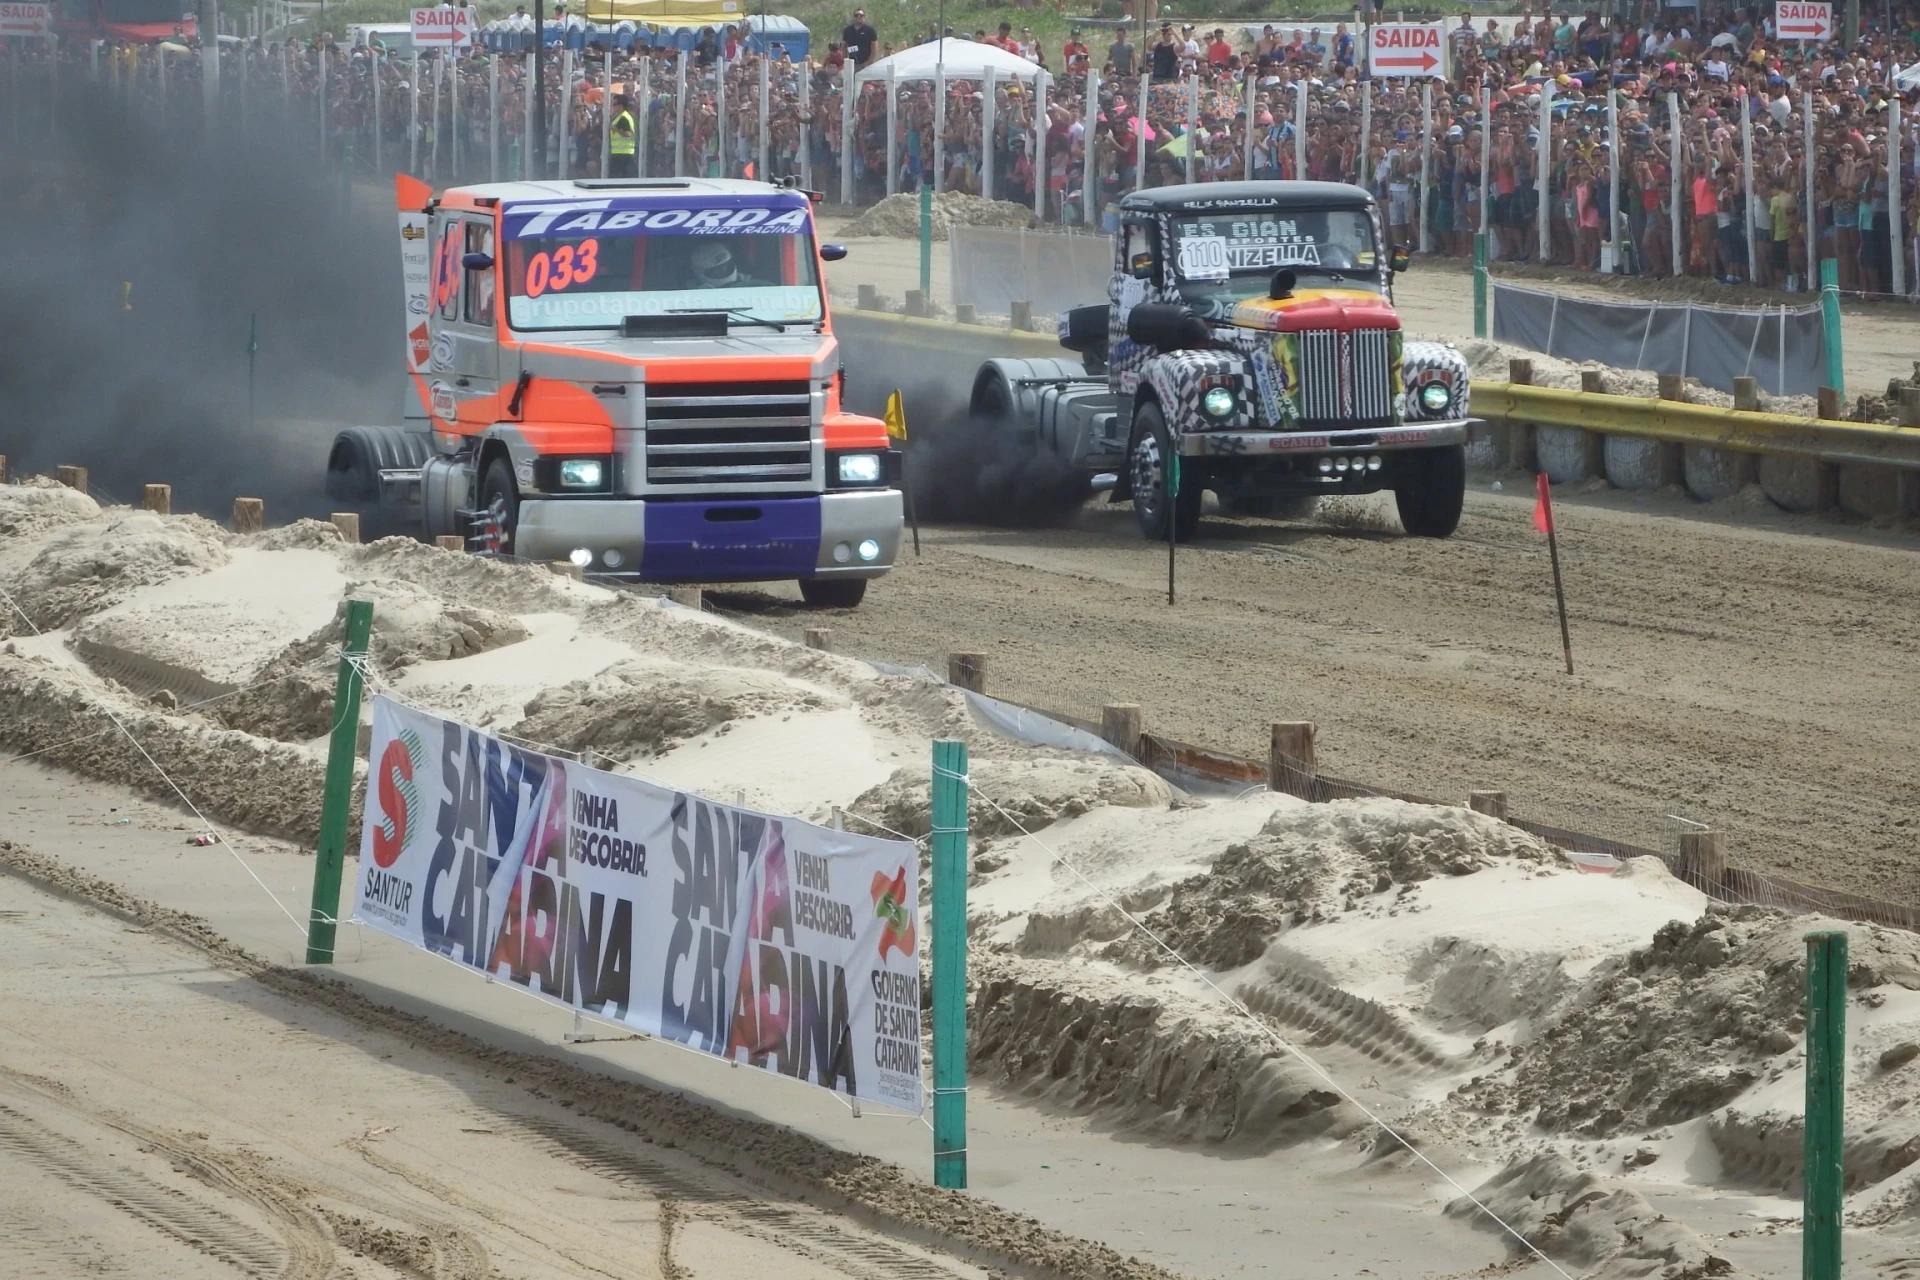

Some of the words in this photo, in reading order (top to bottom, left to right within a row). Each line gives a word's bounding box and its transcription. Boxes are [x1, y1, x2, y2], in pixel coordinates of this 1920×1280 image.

[1, 5, 45, 18] SAIDA
[415, 10, 466, 26] SAIDA
[1779, 4, 1828, 19] SAIDA
[1375, 28, 1440, 48] SAIDA
[503, 200, 808, 237] TABORDA
[688, 225, 741, 235] TRUCK
[740, 224, 801, 234] RACING
[1231, 220, 1297, 238] GIAN
[525, 238, 599, 298] 033
[1186, 240, 1222, 268] 110
[1273, 437, 1324, 448] SCANIA
[1379, 431, 1428, 443] SCANIA
[436, 720, 567, 879] SANTA
[572, 788, 618, 832] VENHA
[569, 825, 648, 877] DESCOBRIR.
[670, 791, 794, 947] SANTA
[364, 867, 412, 914] SANTUR
[794, 850, 830, 894] VENHA
[422, 837, 632, 1020] CATARINA
[795, 889, 856, 940] DESCOBRIR.
[661, 917, 857, 1096] CATARINA
[871, 969, 918, 1008] GOVERNO
[875, 1003, 888, 1035] DE
[889, 1006, 919, 1042] SANTA
[874, 1036, 919, 1077] CATARINA
